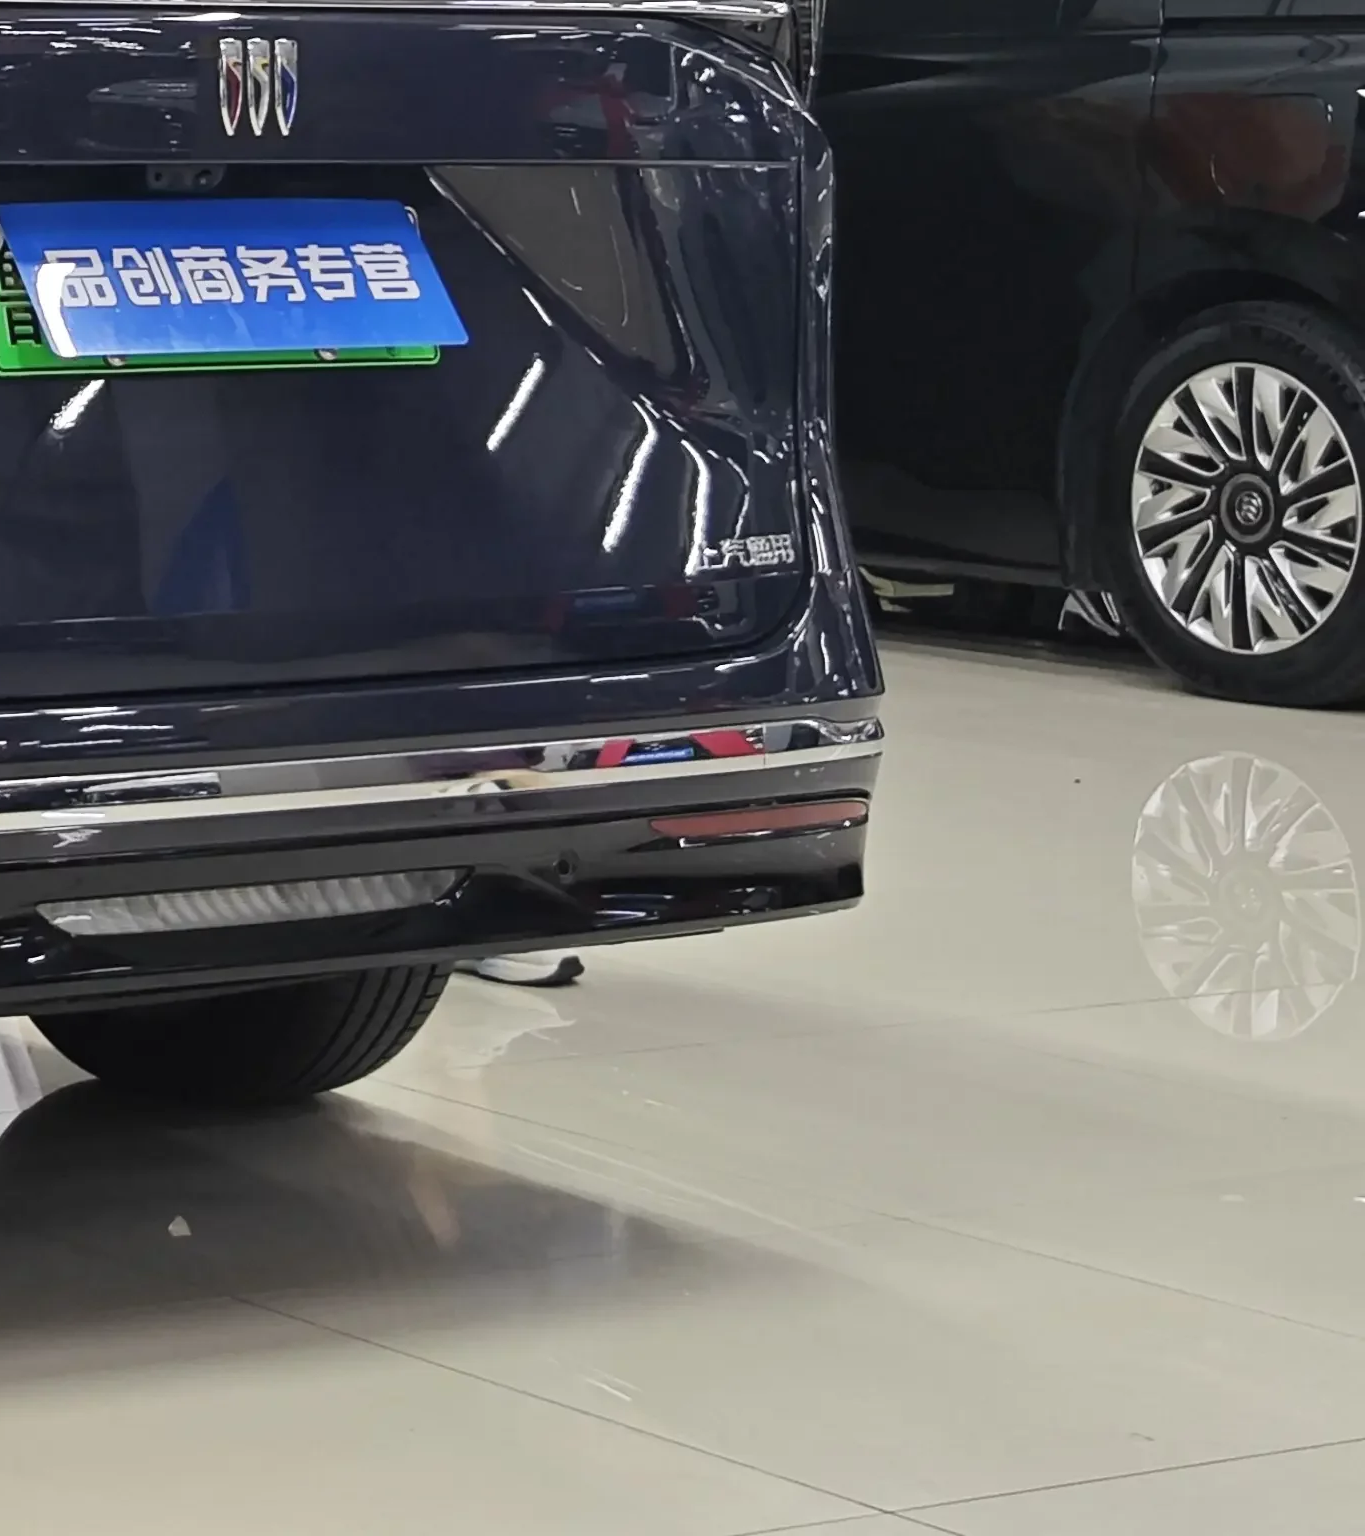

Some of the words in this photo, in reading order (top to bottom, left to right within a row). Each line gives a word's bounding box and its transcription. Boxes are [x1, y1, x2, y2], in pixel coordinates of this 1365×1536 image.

[44, 243, 421, 307] 品创商务专营
